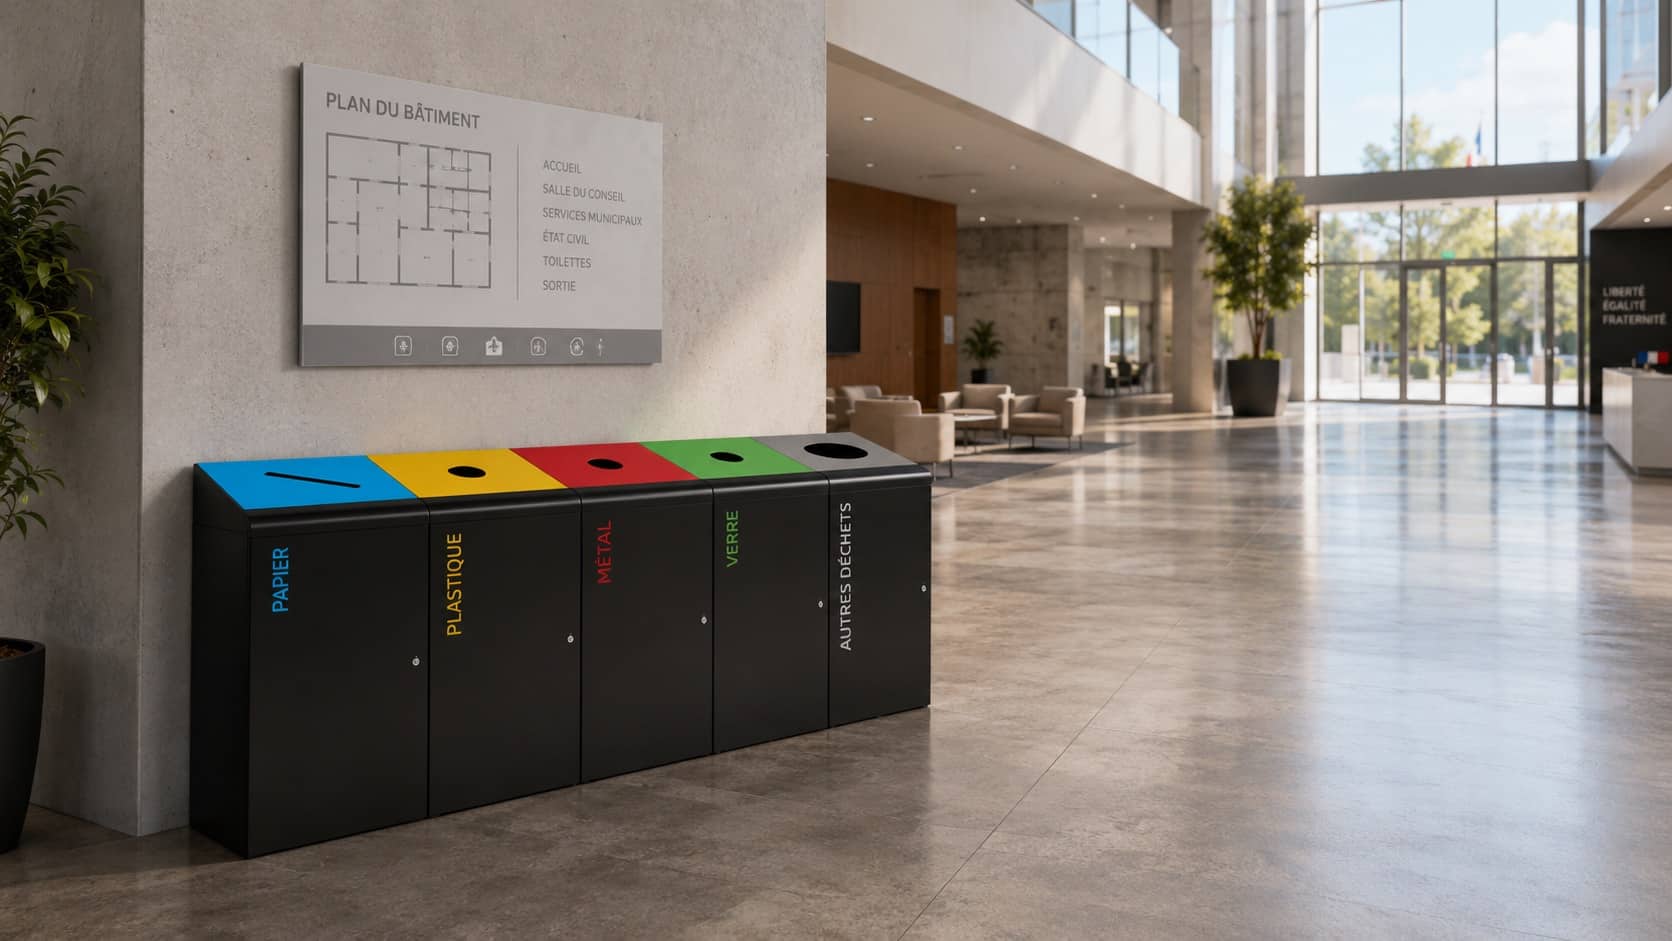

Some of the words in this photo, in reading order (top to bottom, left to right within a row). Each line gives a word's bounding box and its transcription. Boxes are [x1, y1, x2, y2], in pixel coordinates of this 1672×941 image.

[326, 91, 371, 113] PLAN
[376, 99, 399, 118] DU
[404, 102, 480, 129] BÂTIMENT
[543, 160, 582, 174] ACCUEIL
[543, 183, 571, 196] SALLE
[573, 186, 587, 199] DU
[588, 188, 625, 202] CONSEIL
[543, 207, 586, 221] SERVICES
[588, 211, 643, 226] MUNICIPAUX
[543, 229, 565, 243] ÉTAT
[566, 233, 590, 245] CIVIL
[543, 256, 592, 268] TOILETTES
[543, 280, 576, 291] SORTIE
[1602, 285, 1645, 297] LIBERTÉ
[1602, 299, 1646, 311] ÉGALITÉ
[1602, 312, 1667, 325] FRATERNITÉ
[726, 510, 739, 568] VERRE
[837, 502, 852, 579] DÉCHETS
[595, 520, 612, 584] MÉTAL
[272, 546, 289, 613] PAPIER
[446, 532, 462, 637] PLASTIQUE
[839, 583, 852, 651] AUTRES
